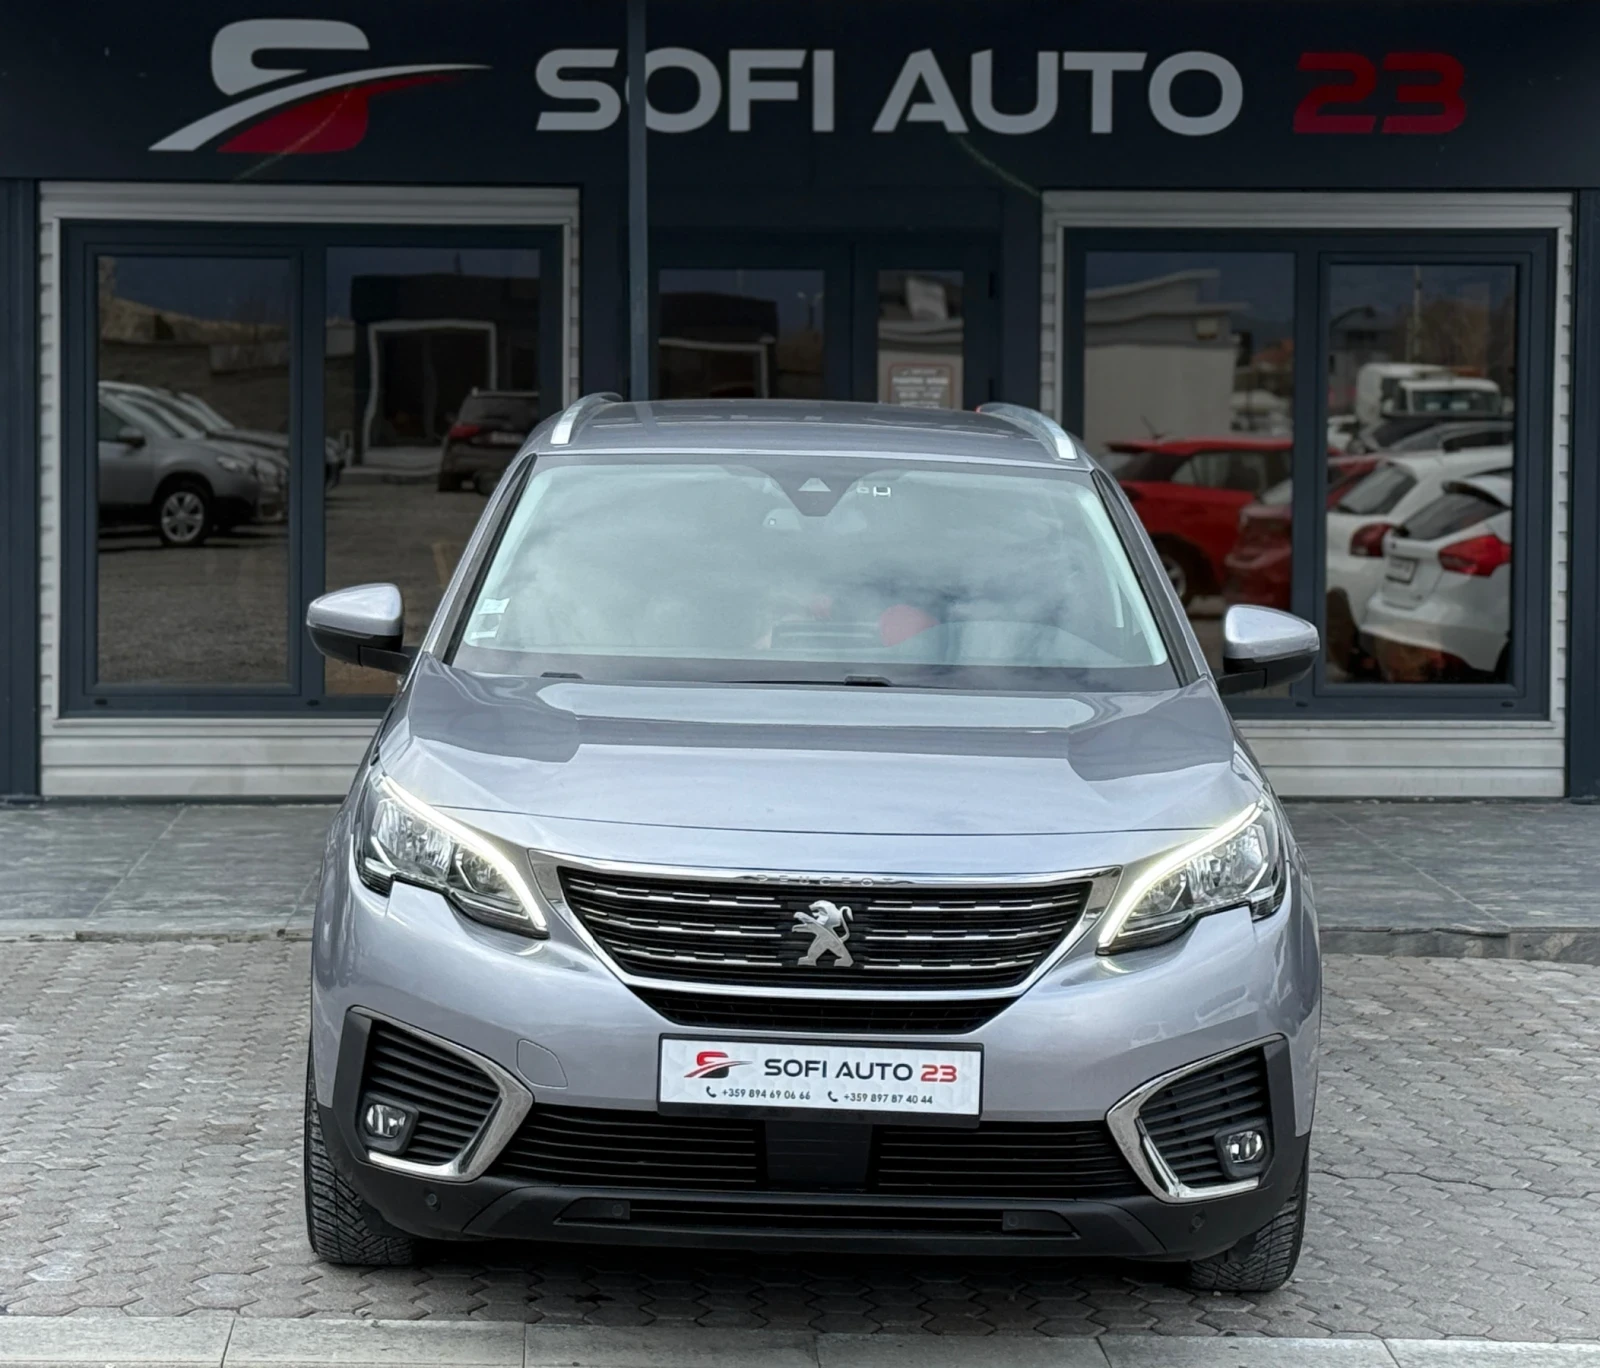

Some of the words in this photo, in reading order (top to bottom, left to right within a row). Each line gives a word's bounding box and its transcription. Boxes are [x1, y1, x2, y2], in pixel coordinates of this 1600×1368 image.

[535, 47, 834, 133] SOFI
[872, 49, 1244, 136] AUTO
[1293, 52, 1467, 135] 23
[764, 1058, 827, 1078] SOFI
[835, 1061, 913, 1082] AUTO
[920, 1064, 957, 1083] 23
[722, 1088, 746, 1098] +359
[748, 1089, 767, 1099] 894
[769, 1090, 781, 1099] 69
[784, 1090, 796, 1100] 06
[799, 1091, 811, 1100] 66
[843, 1092, 868, 1102] +359
[870, 1093, 889, 1103] 897
[891, 1094, 904, 1103] 87
[905, 1095, 919, 1104] 40
[920, 1095, 933, 1104] 44
